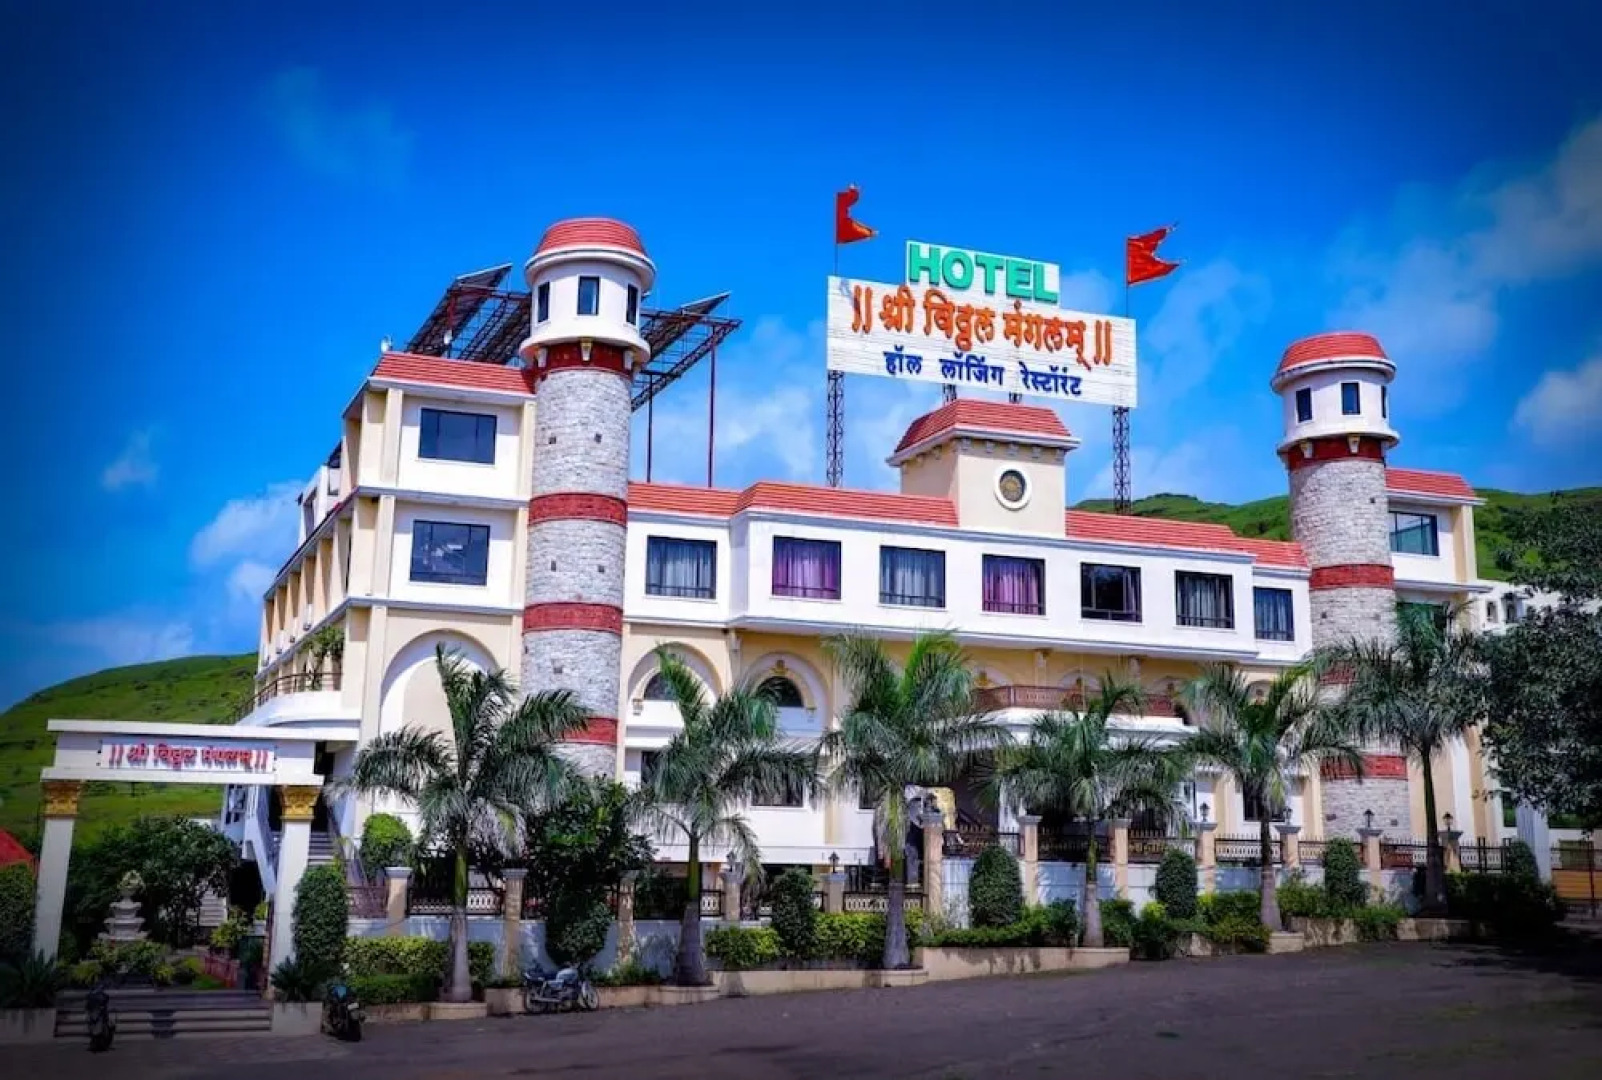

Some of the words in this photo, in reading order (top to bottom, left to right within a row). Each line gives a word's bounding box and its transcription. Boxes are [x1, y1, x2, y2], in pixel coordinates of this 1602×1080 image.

[908, 243, 1059, 304] HOTEL
[879, 285, 916, 333] श्री
[923, 288, 996, 351] विठ्ठल
[1002, 300, 1091, 371] मंगलम्
[883, 345, 923, 375] हॉल
[939, 352, 1005, 386] लॉजिंग
[1018, 361, 1082, 396] रेस्टॉरंट
